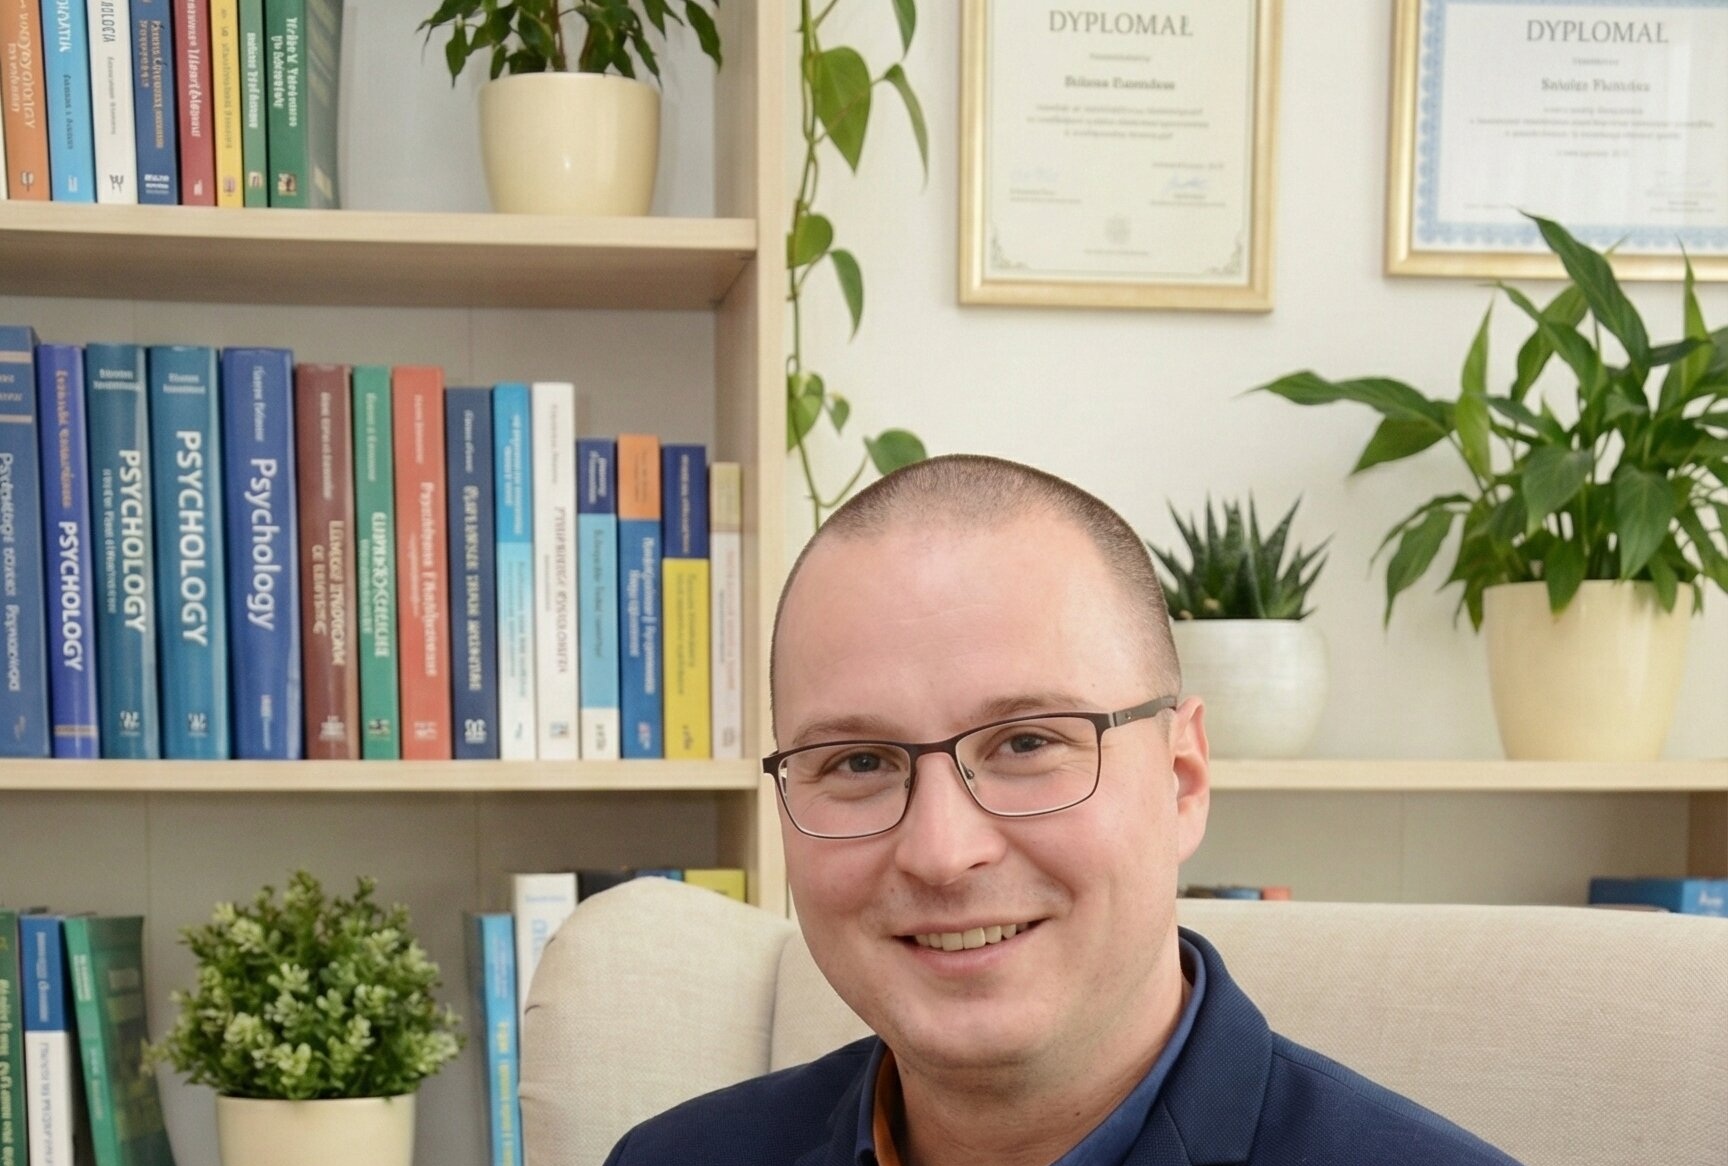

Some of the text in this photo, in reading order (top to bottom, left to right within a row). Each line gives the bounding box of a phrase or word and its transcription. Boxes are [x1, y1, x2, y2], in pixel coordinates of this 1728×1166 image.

[58, 521, 84, 672] PSYCHOLOGY
[118, 449, 147, 633] PSYCHOLOGY
[176, 430, 209, 647] PSYCHOLOGY
[244, 458, 283, 631] Psychology
